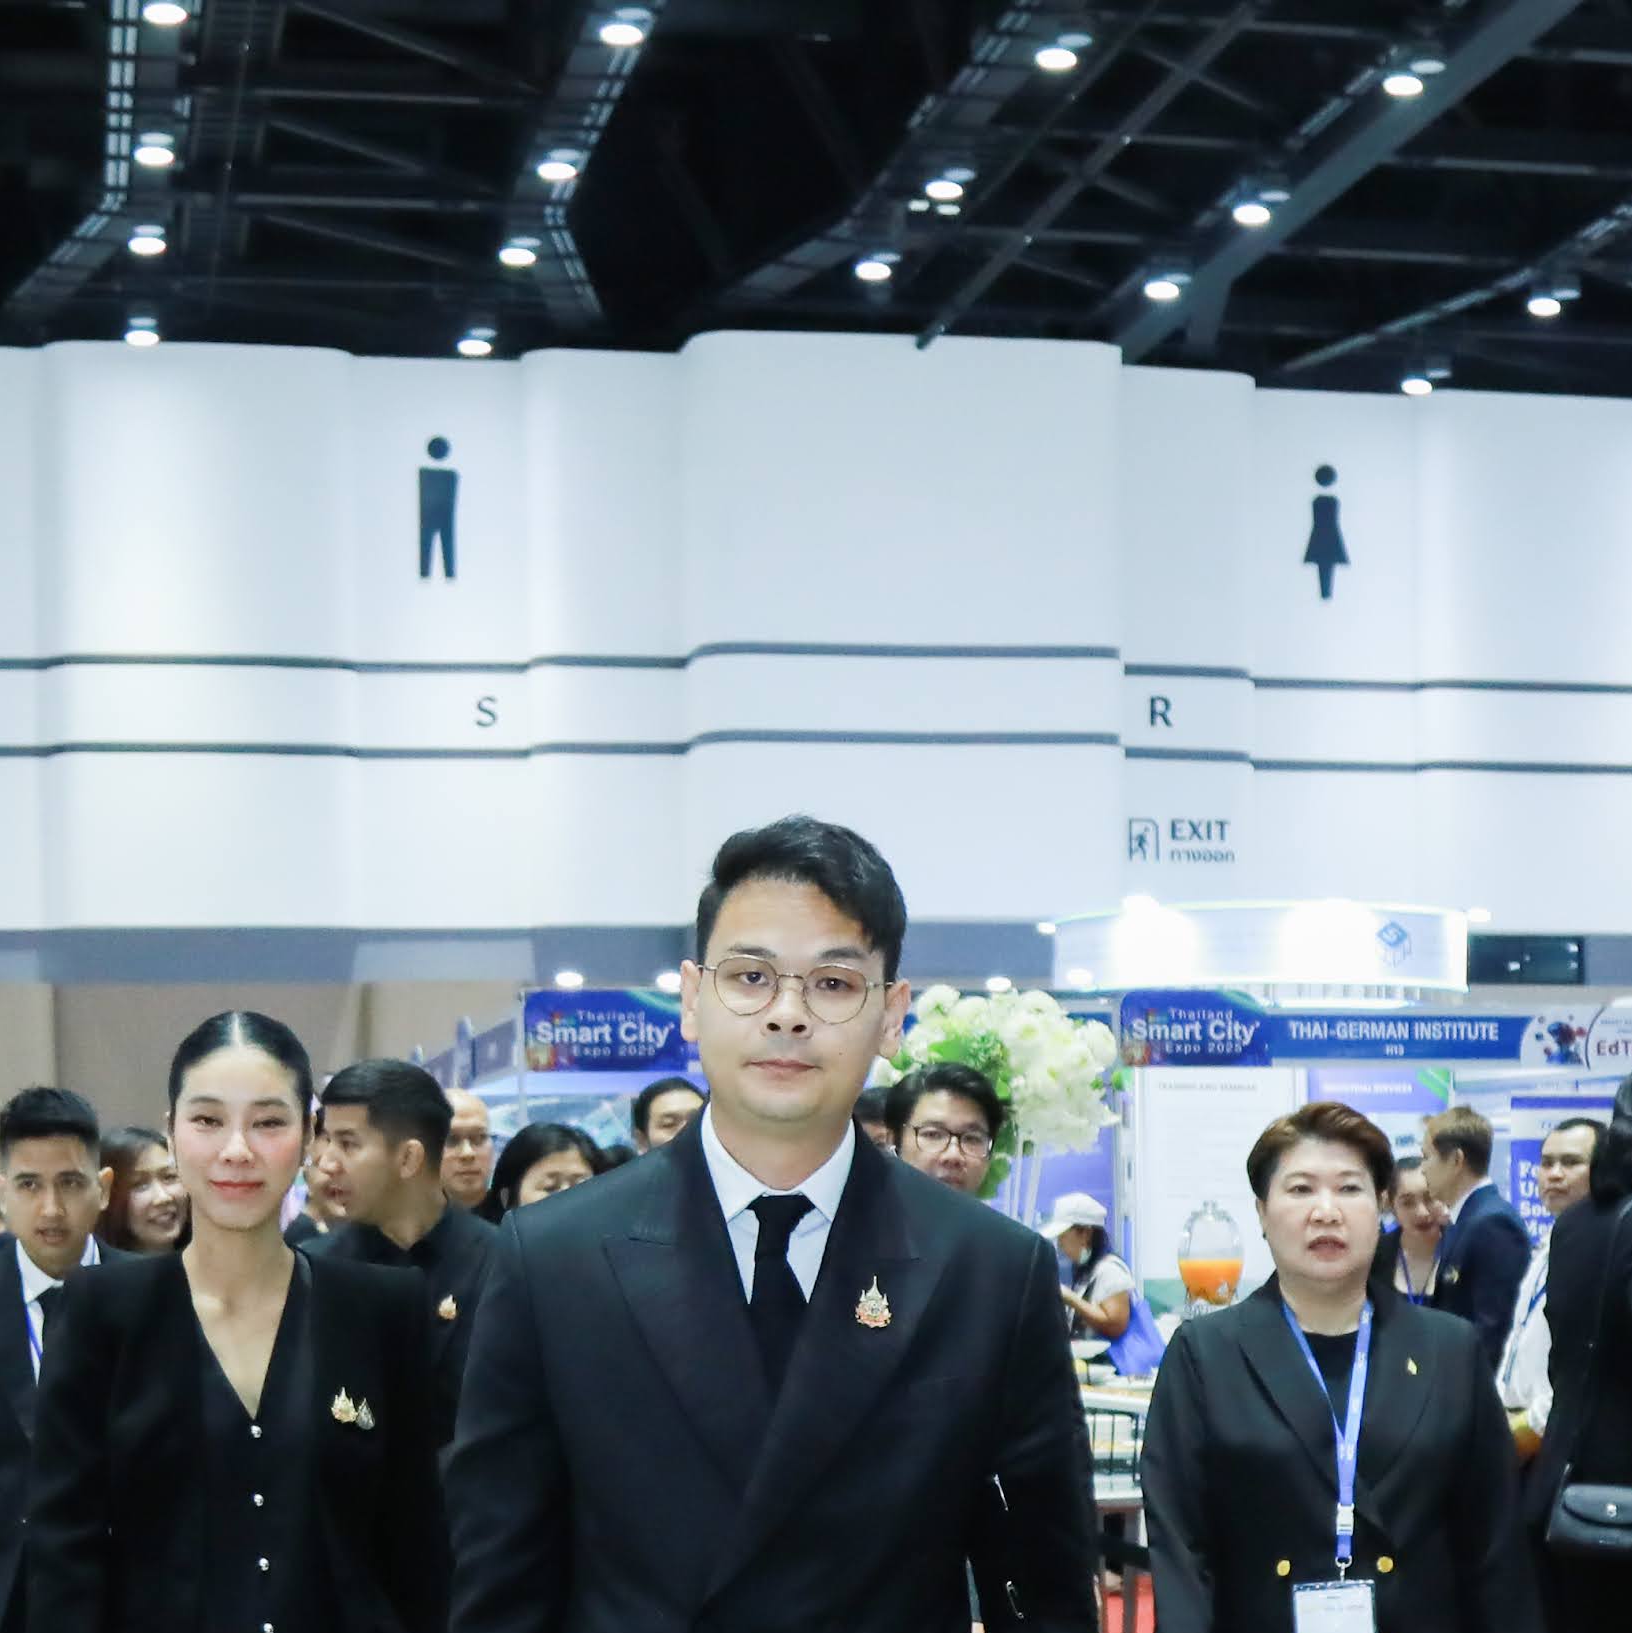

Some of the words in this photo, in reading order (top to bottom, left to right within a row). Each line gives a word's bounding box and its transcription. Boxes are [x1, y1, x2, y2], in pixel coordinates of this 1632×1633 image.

[474, 695, 499, 728] S
[1149, 696, 1173, 728] R
[1170, 819, 1230, 841] EXIT
[1170, 1007, 1234, 1020] Thailand
[535, 1020, 612, 1044] Smart
[619, 1021, 670, 1049] City
[1132, 1018, 1203, 1042] Smart
[1209, 1019, 1256, 1047] City
[1288, 1020, 1412, 1041] THAI-GERMAN
[1414, 1021, 1499, 1041] INSTITUTE
[1166, 1043, 1202, 1055] Expo
